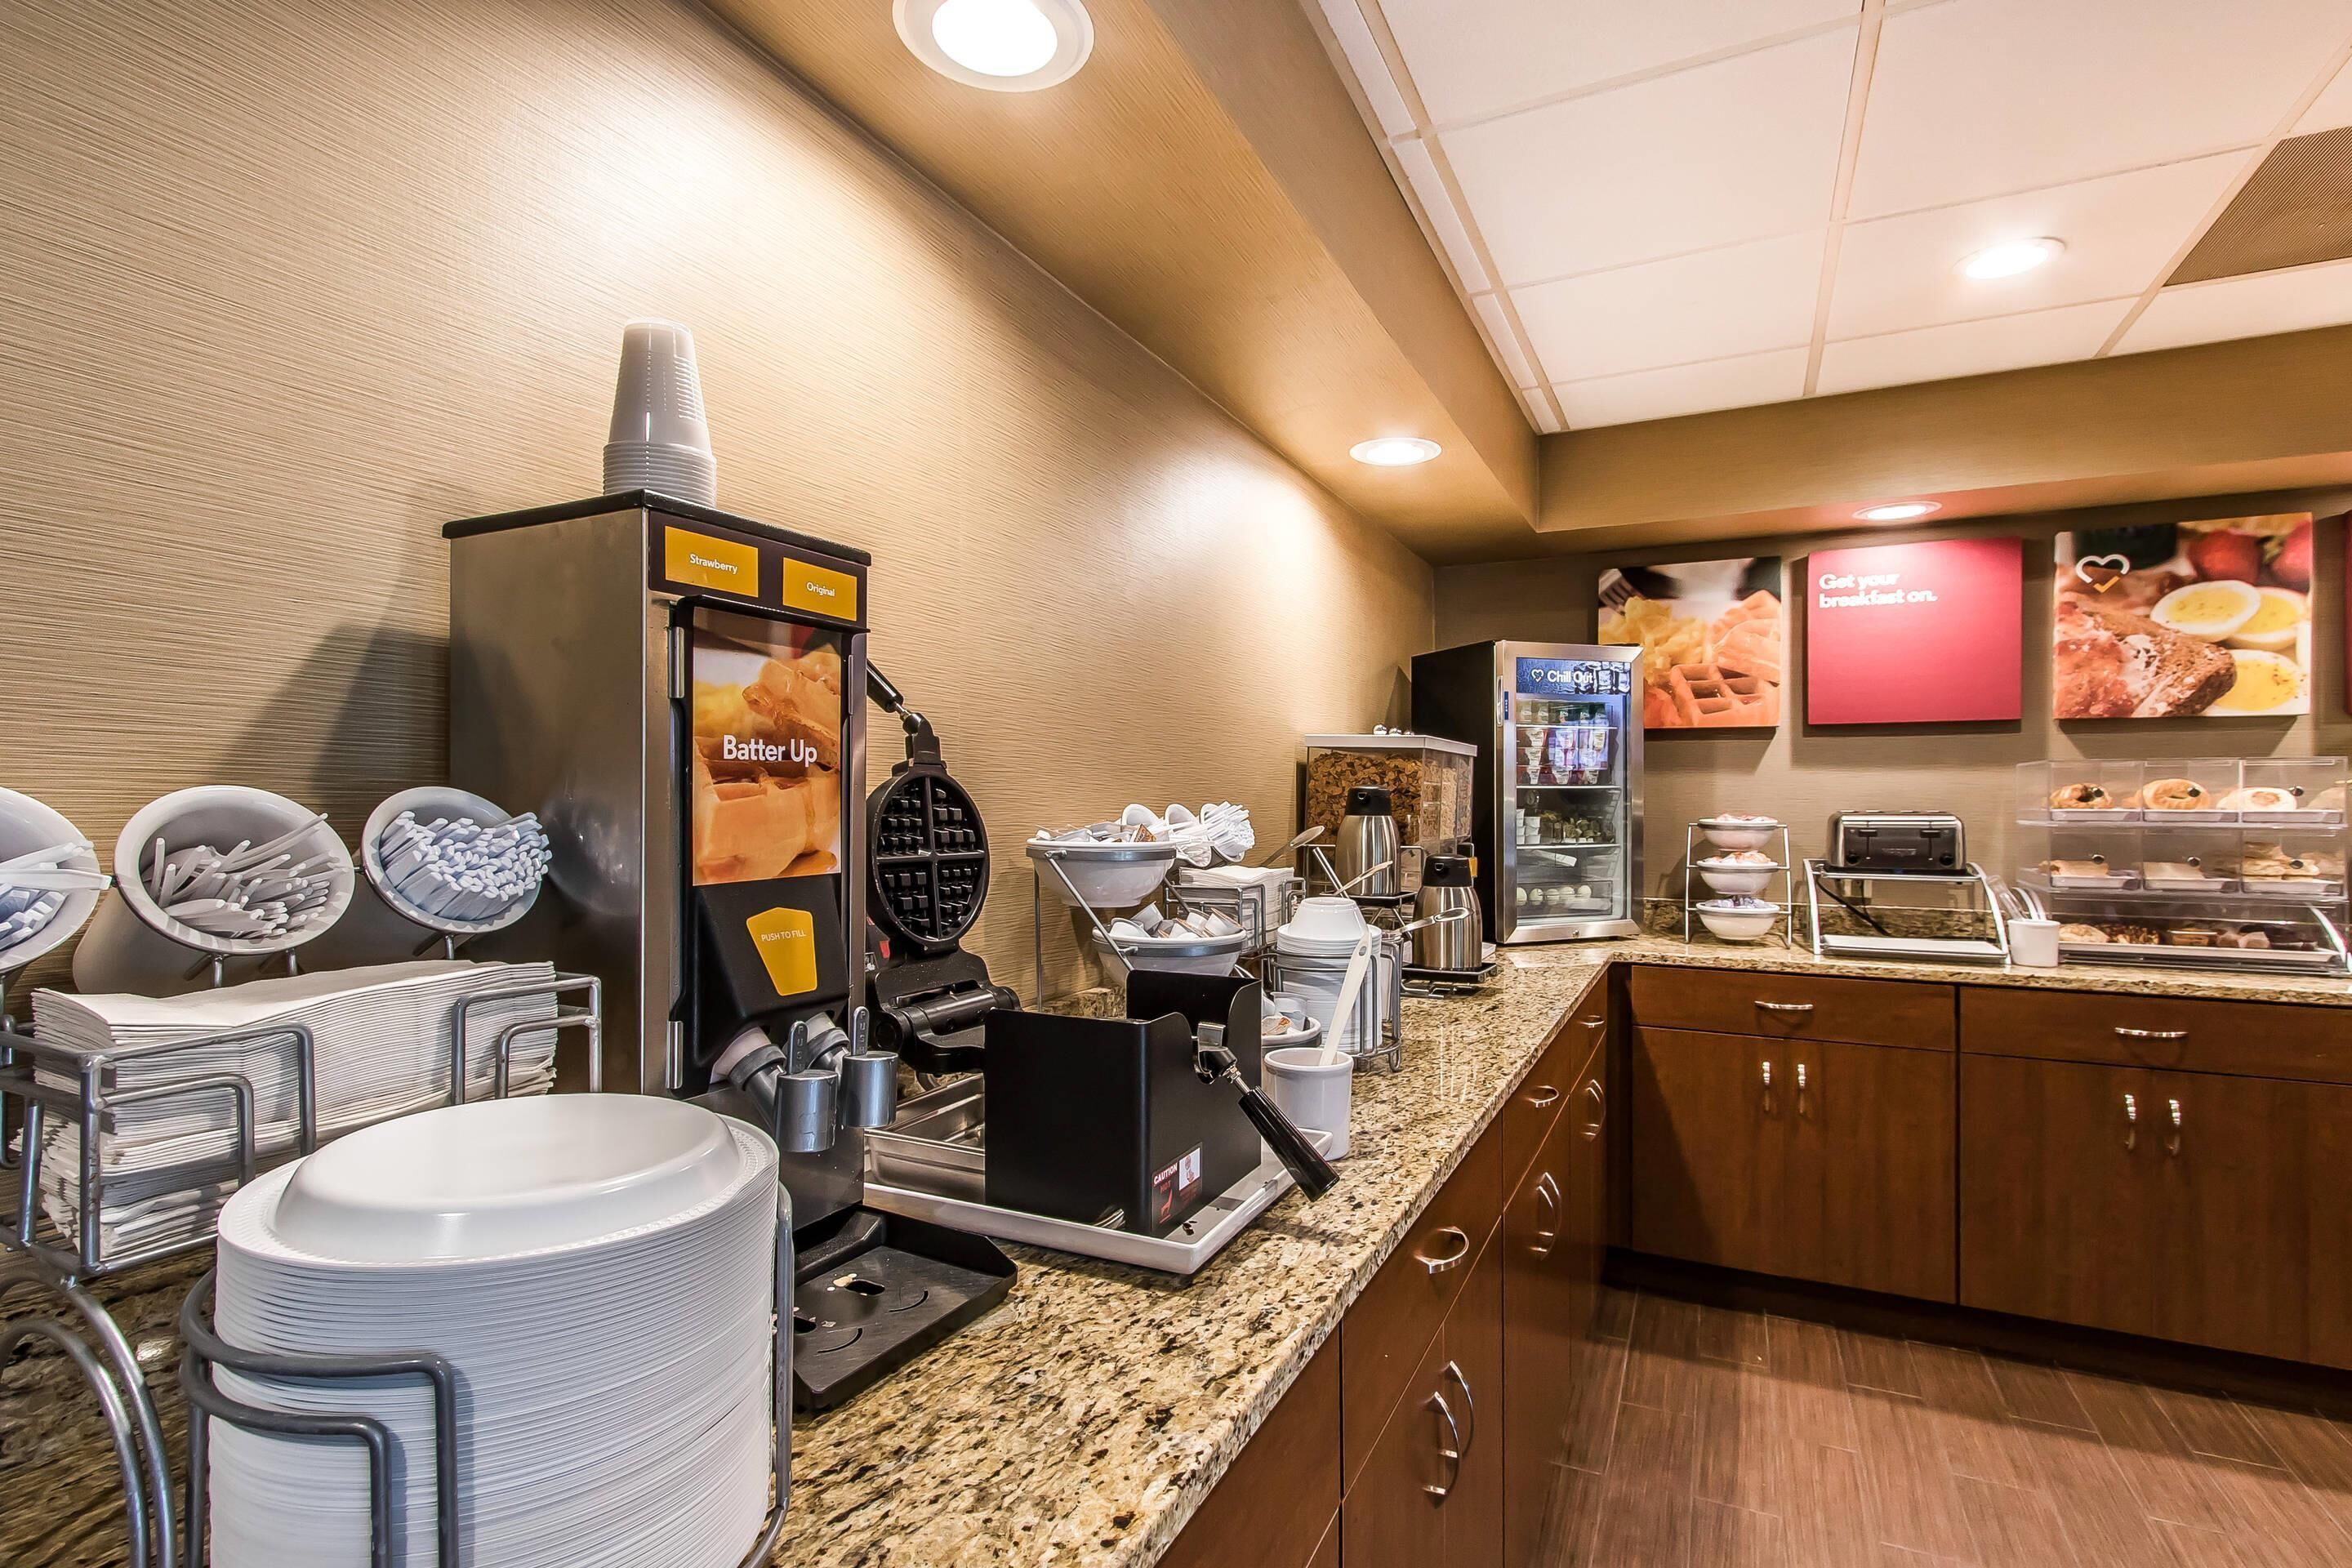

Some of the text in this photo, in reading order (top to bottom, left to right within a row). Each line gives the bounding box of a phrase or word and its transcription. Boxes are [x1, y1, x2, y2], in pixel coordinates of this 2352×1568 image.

[689, 553, 738, 575] Strawberry
[806, 581, 835, 597] Original
[1818, 573, 1900, 590] Get your
[1819, 589, 1939, 608] breakfast on.
[1547, 670, 1593, 684] Chill Out
[723, 734, 817, 768] Batter Up
[760, 929, 807, 942] PUSH TO FILL
[1153, 1162, 1178, 1185] CAUTION
